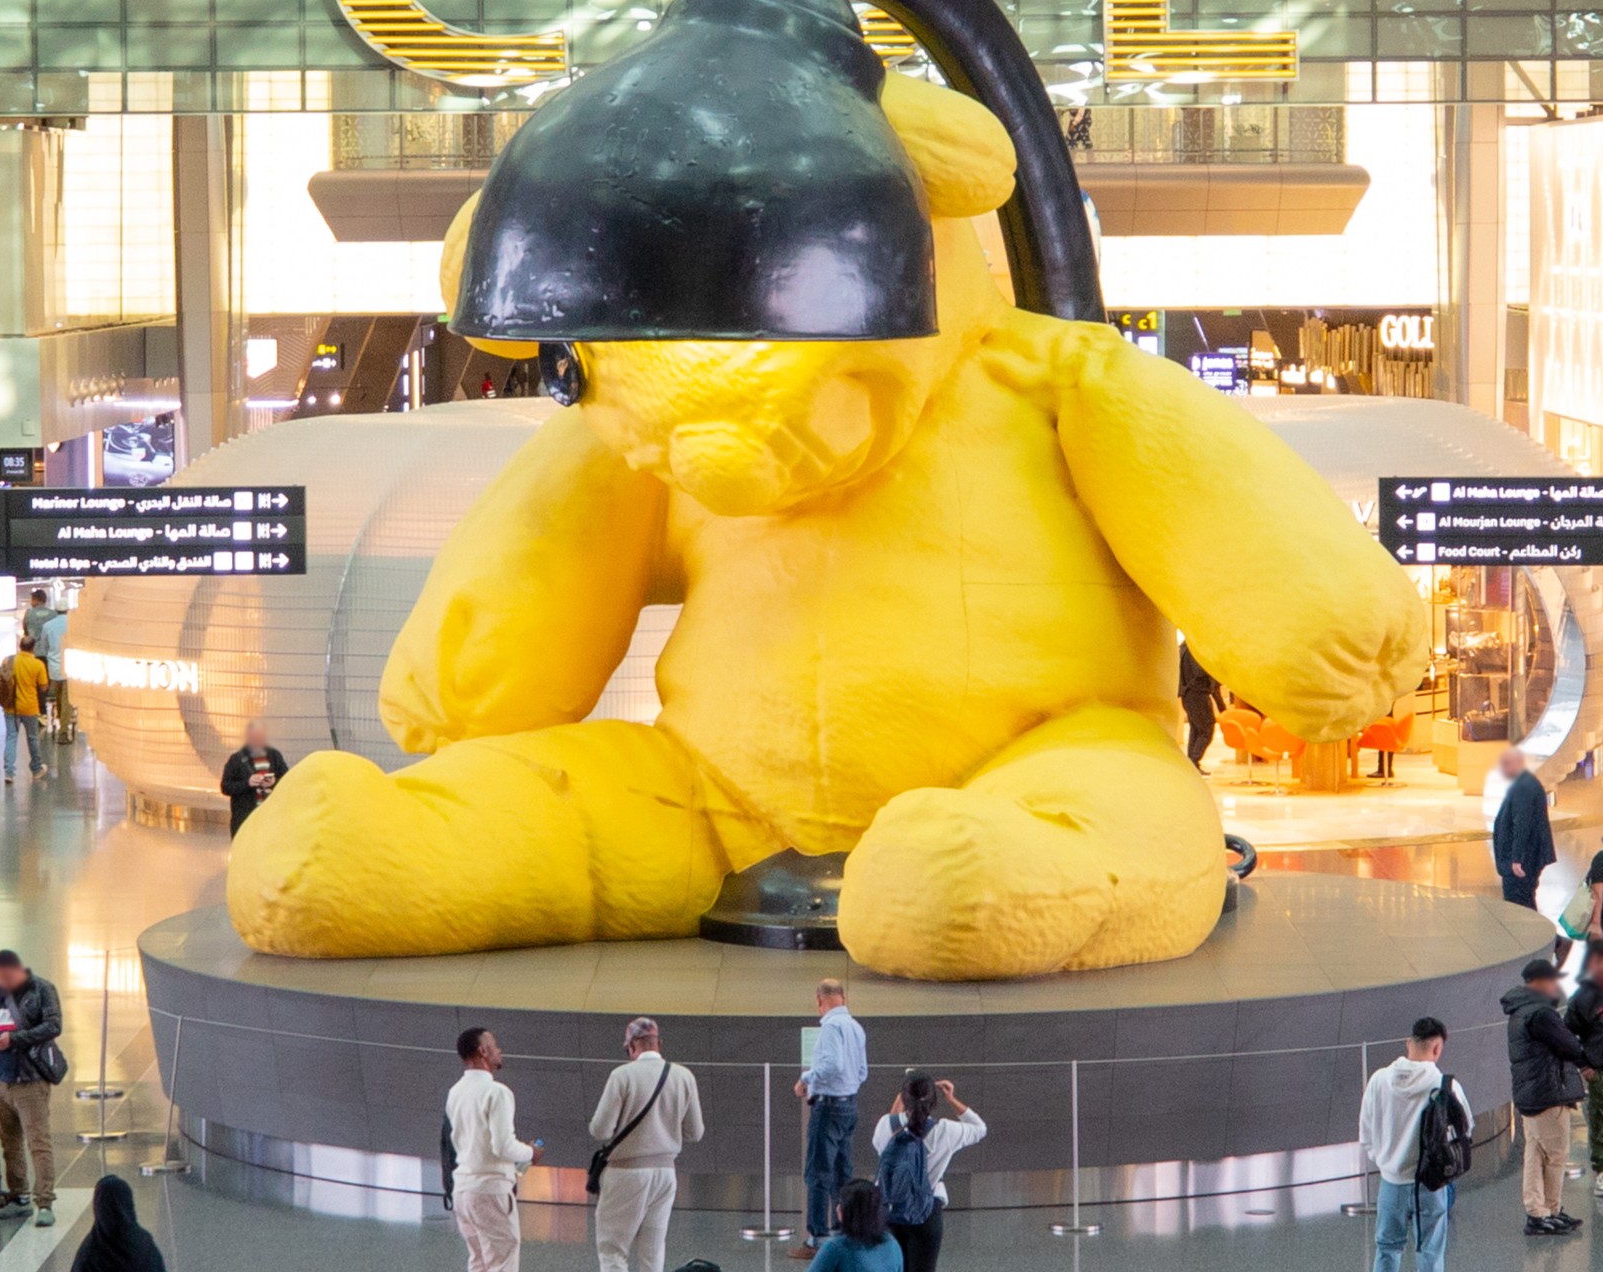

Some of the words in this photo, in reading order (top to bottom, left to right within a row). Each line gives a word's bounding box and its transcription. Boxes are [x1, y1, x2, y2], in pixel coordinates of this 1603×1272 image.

[1437, 545, 1467, 558] Food
[1467, 546, 1501, 558] Court
[1508, 544, 1558, 561] المطاعم
[1559, 545, 1582, 560] ركن
